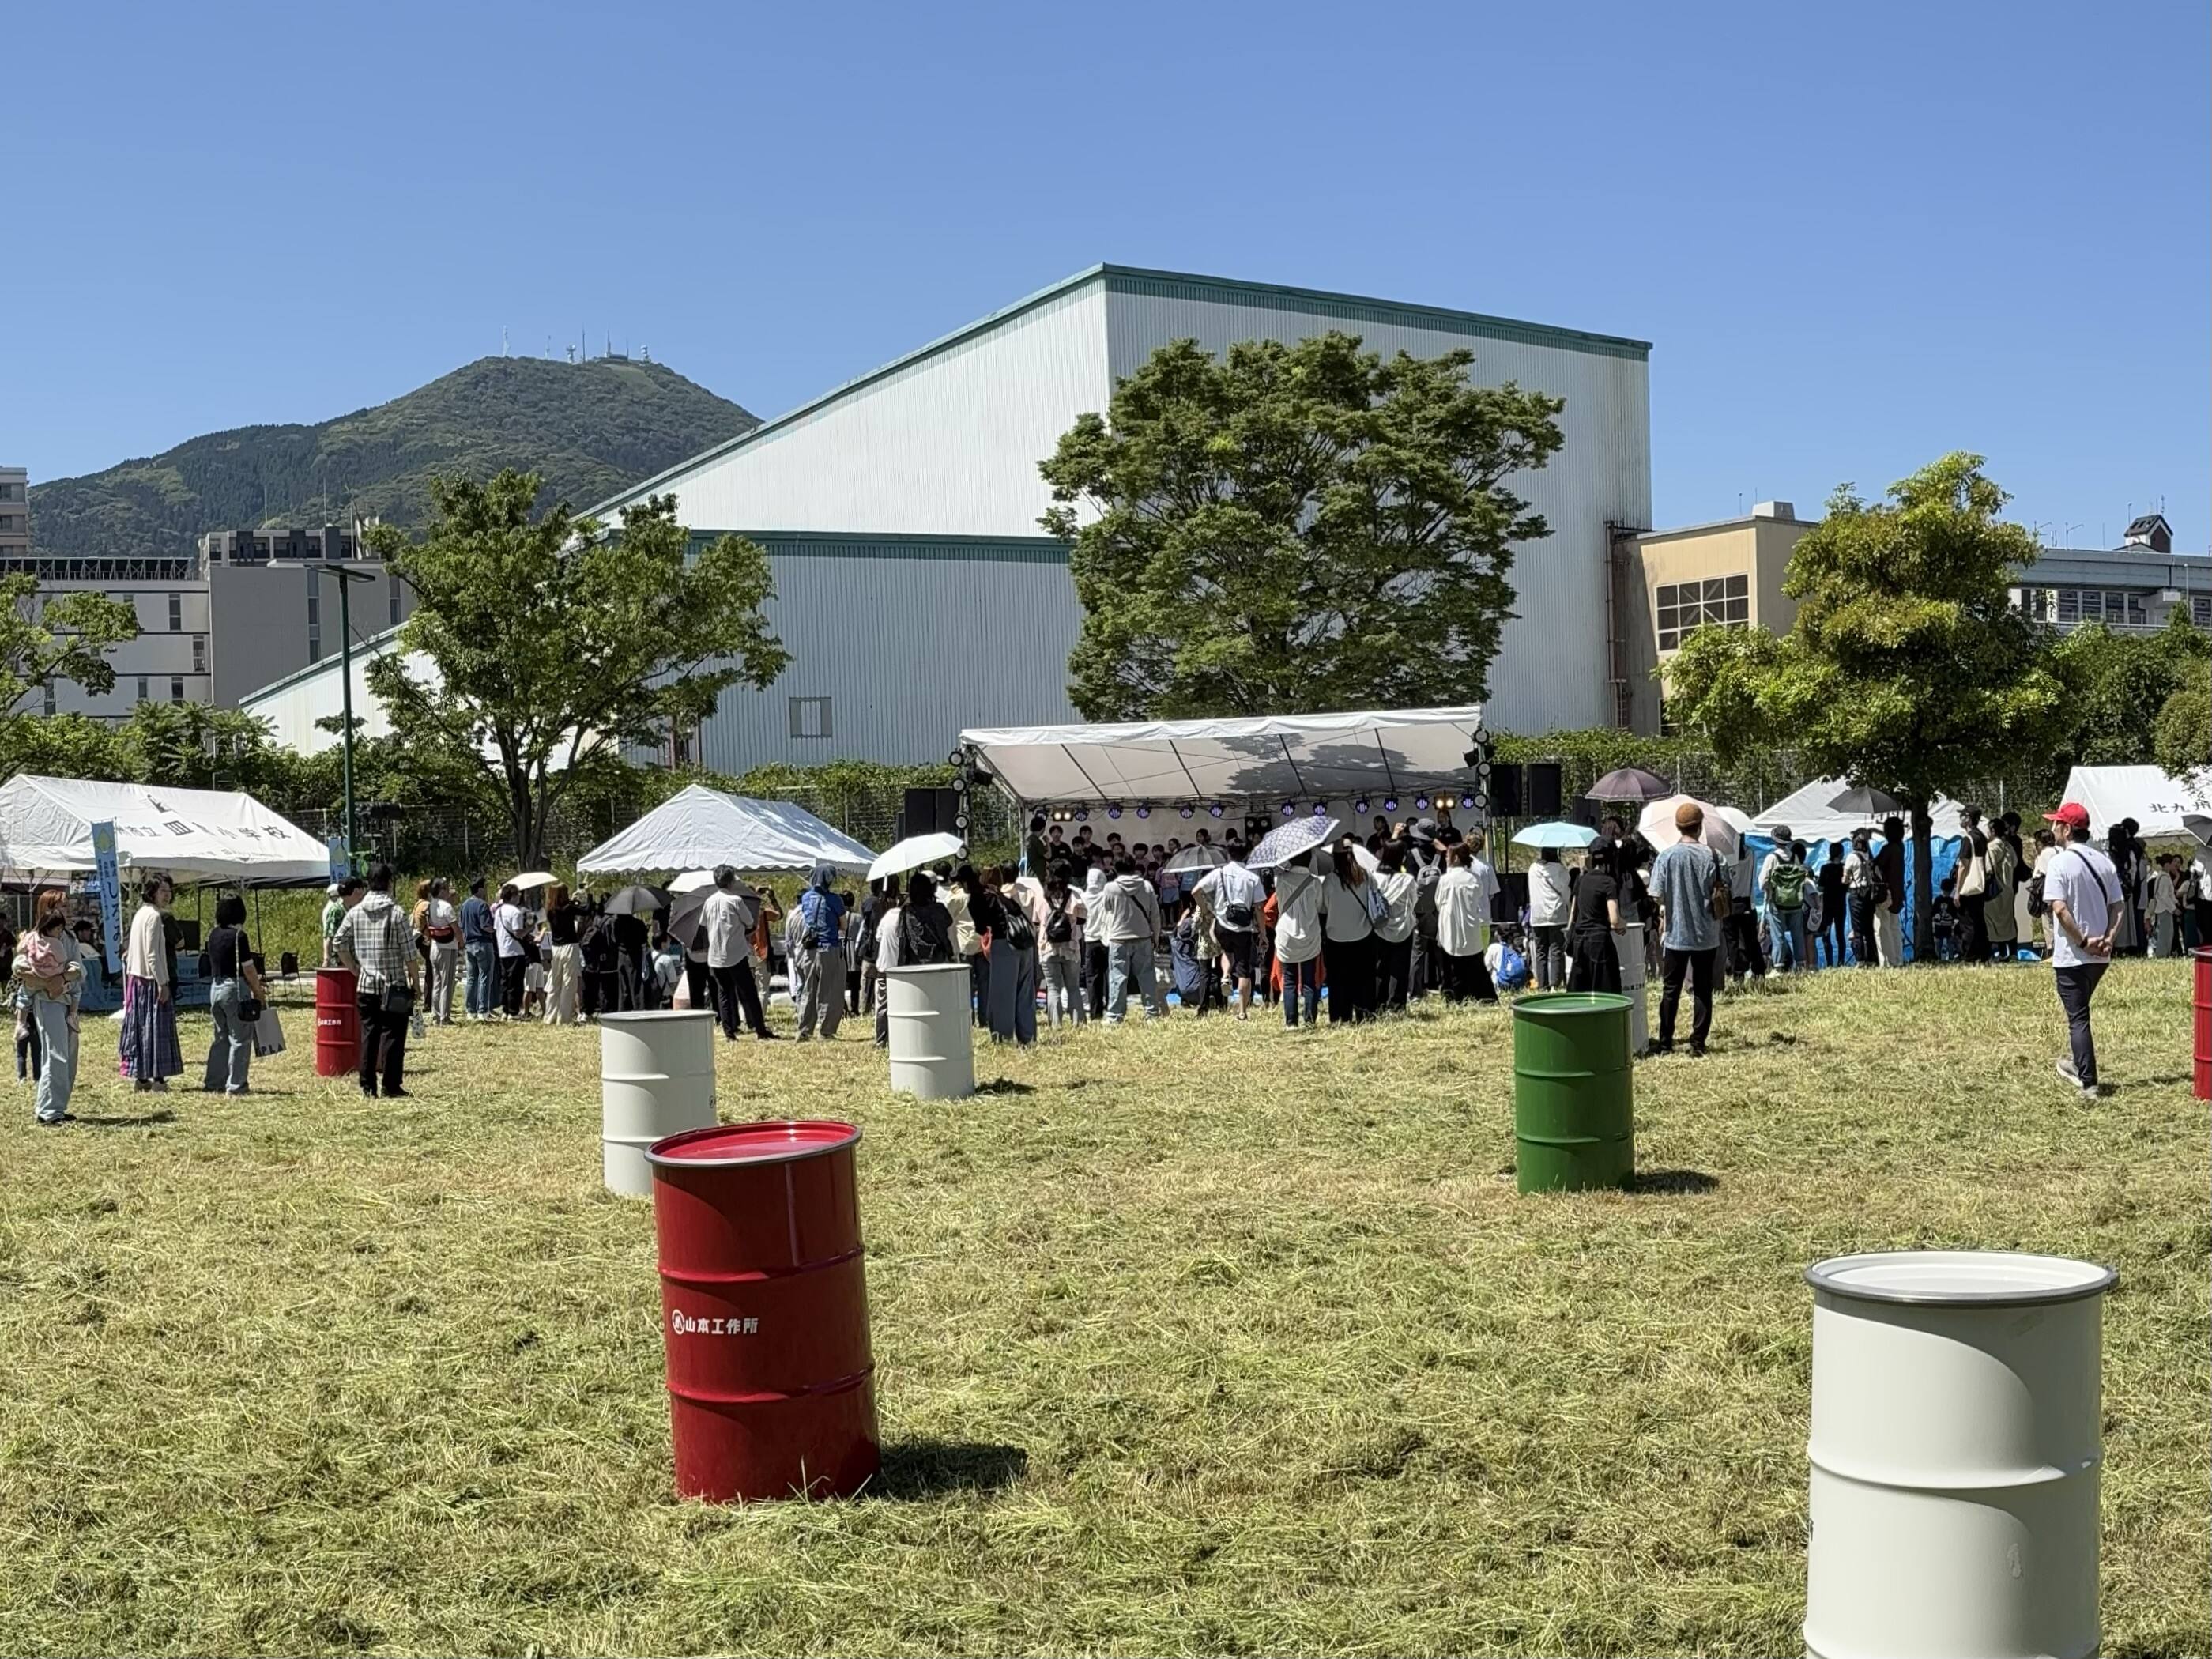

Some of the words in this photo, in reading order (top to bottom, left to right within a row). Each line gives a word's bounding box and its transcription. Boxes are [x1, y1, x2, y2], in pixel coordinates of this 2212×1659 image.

[685, 1315, 759, 1335] 山本工作所
